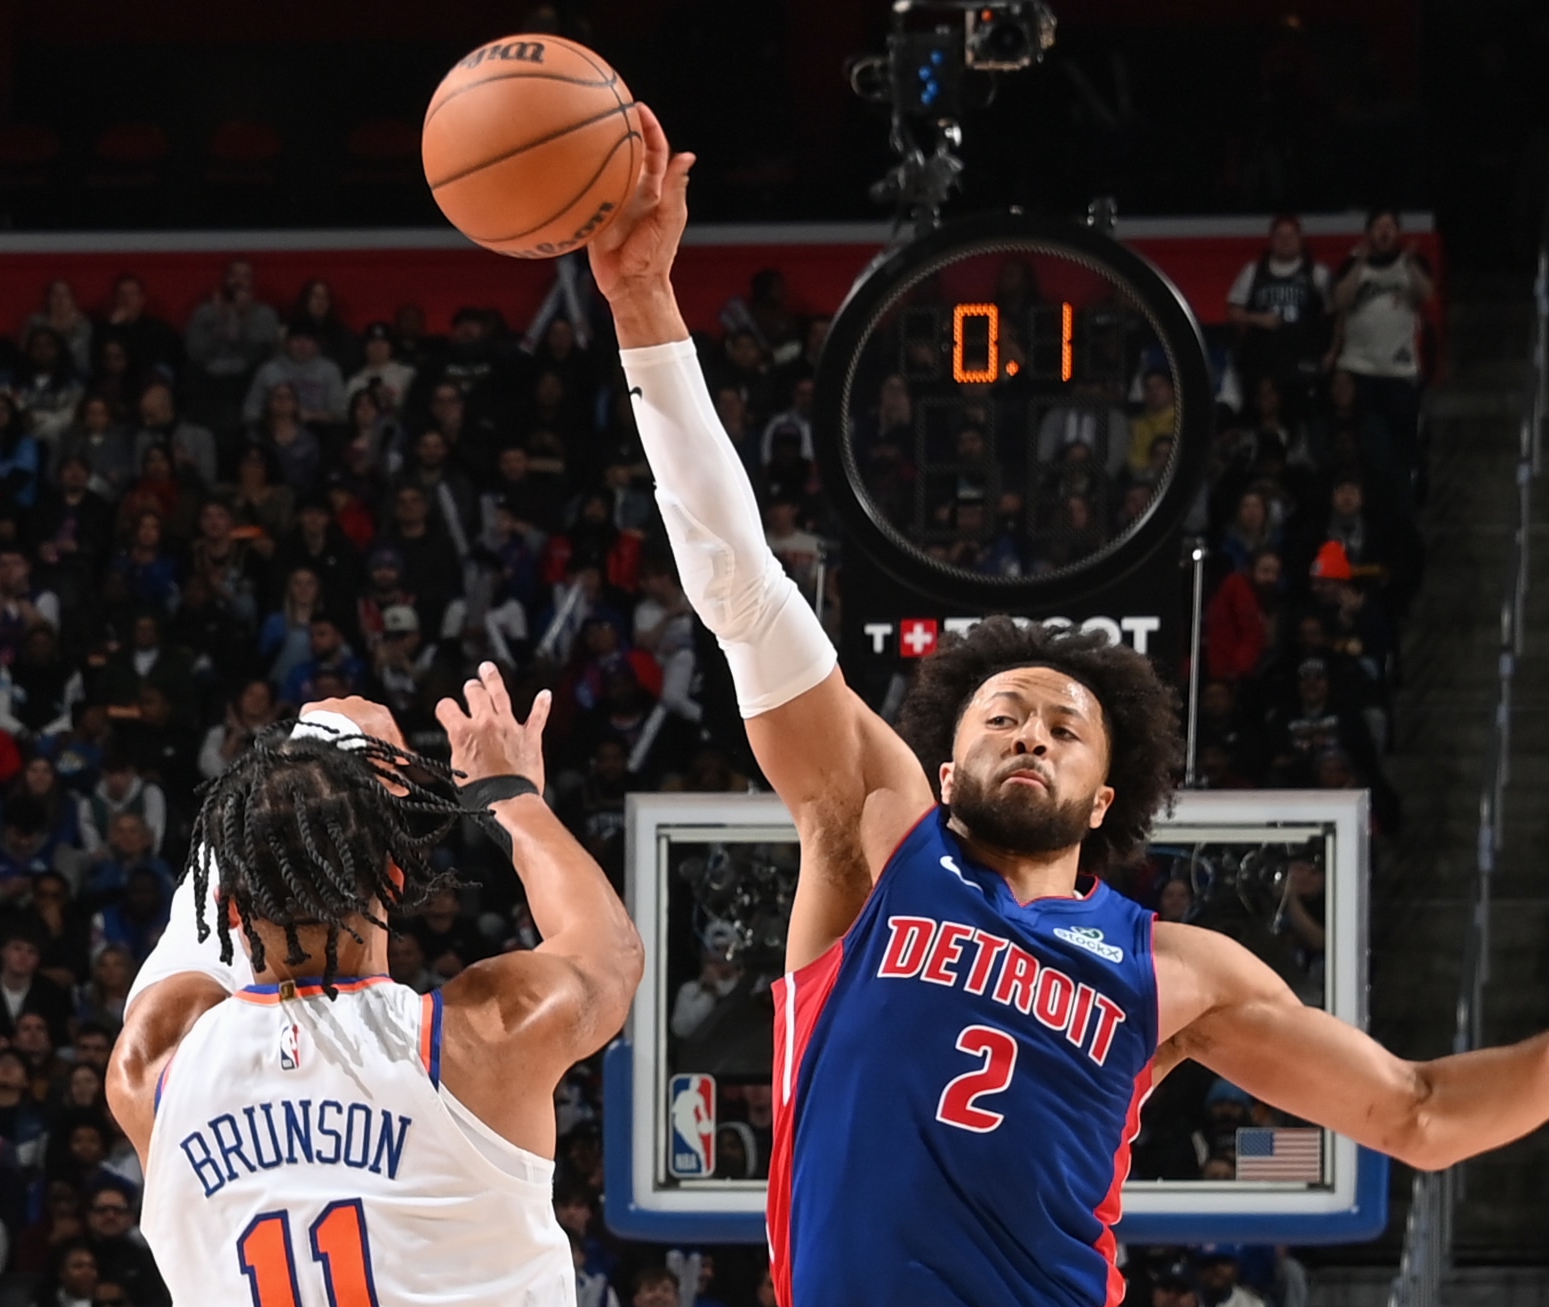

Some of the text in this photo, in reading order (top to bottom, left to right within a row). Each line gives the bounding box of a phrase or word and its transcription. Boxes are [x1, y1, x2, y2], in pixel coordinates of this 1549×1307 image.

[953, 302, 1072, 383] 0.1
[877, 916, 1125, 1067] DETROIT
[936, 1024, 1018, 1133] 2
[180, 1100, 412, 1198] BRUNSON
